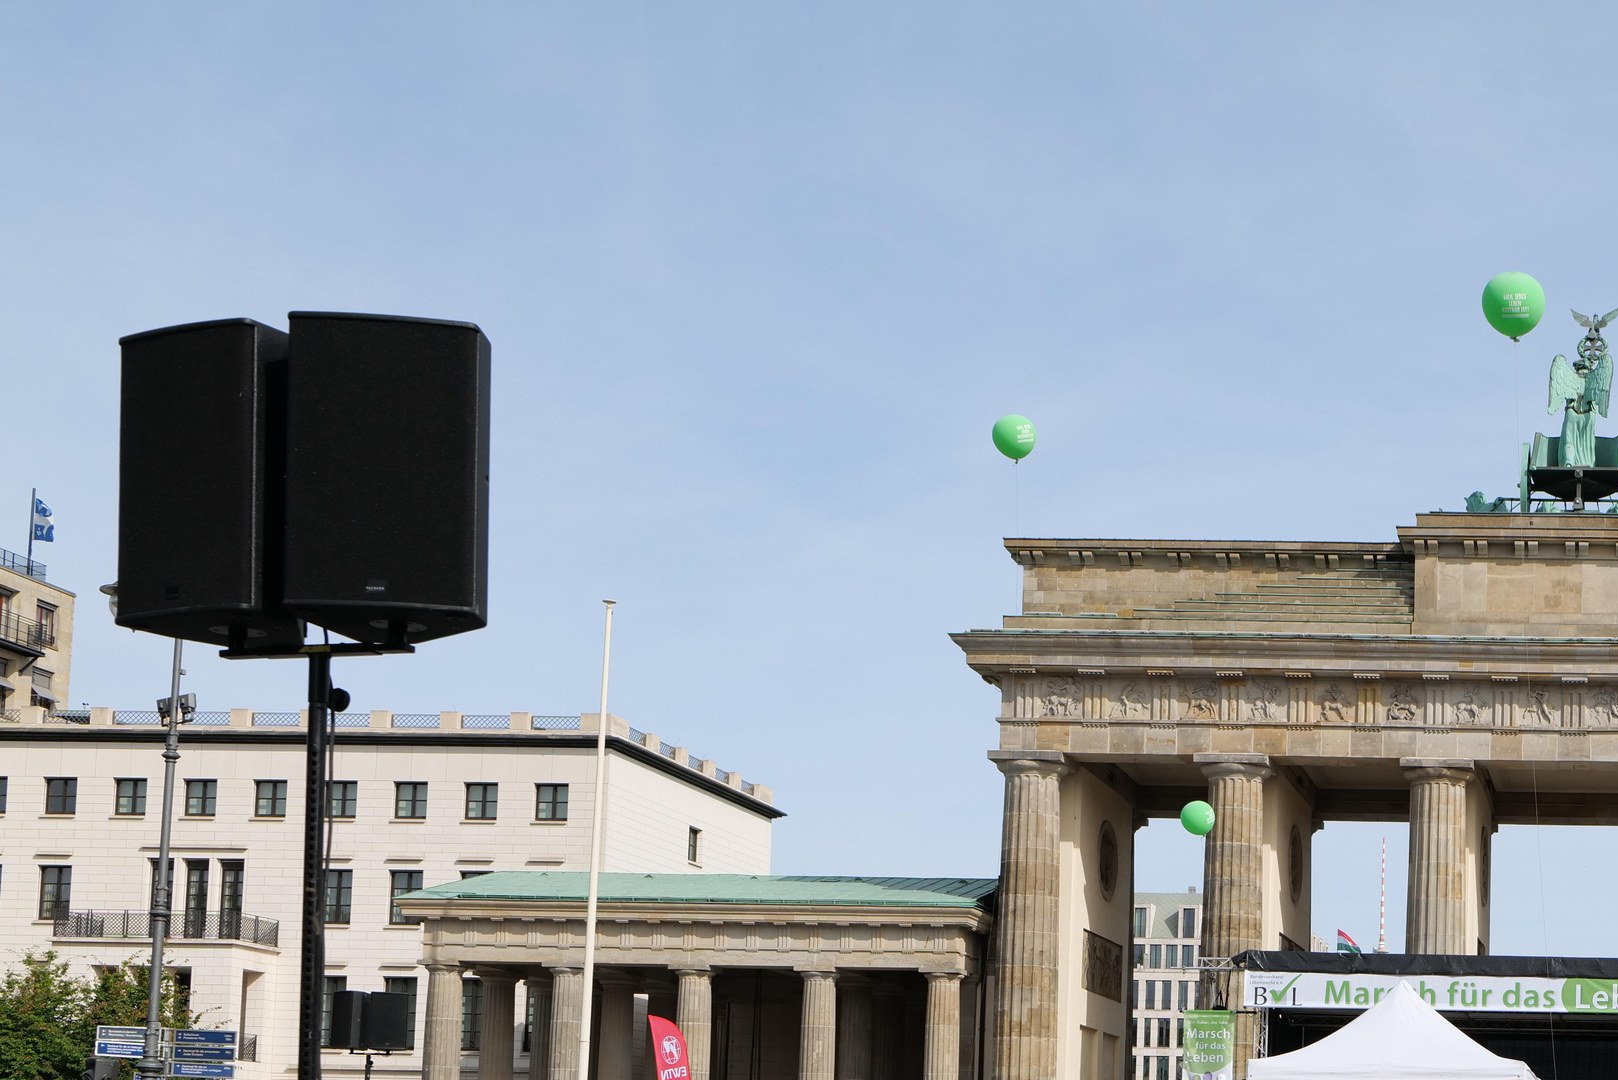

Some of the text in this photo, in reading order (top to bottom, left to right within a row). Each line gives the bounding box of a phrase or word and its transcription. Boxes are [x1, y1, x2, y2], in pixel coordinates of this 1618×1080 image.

[1324, 980, 1436, 1006] Marh
[1447, 980, 1492, 1008] für
[1502, 982, 1556, 1008] das
[1186, 1027, 1231, 1039] Marsch
[1195, 1041, 1226, 1050] für das
